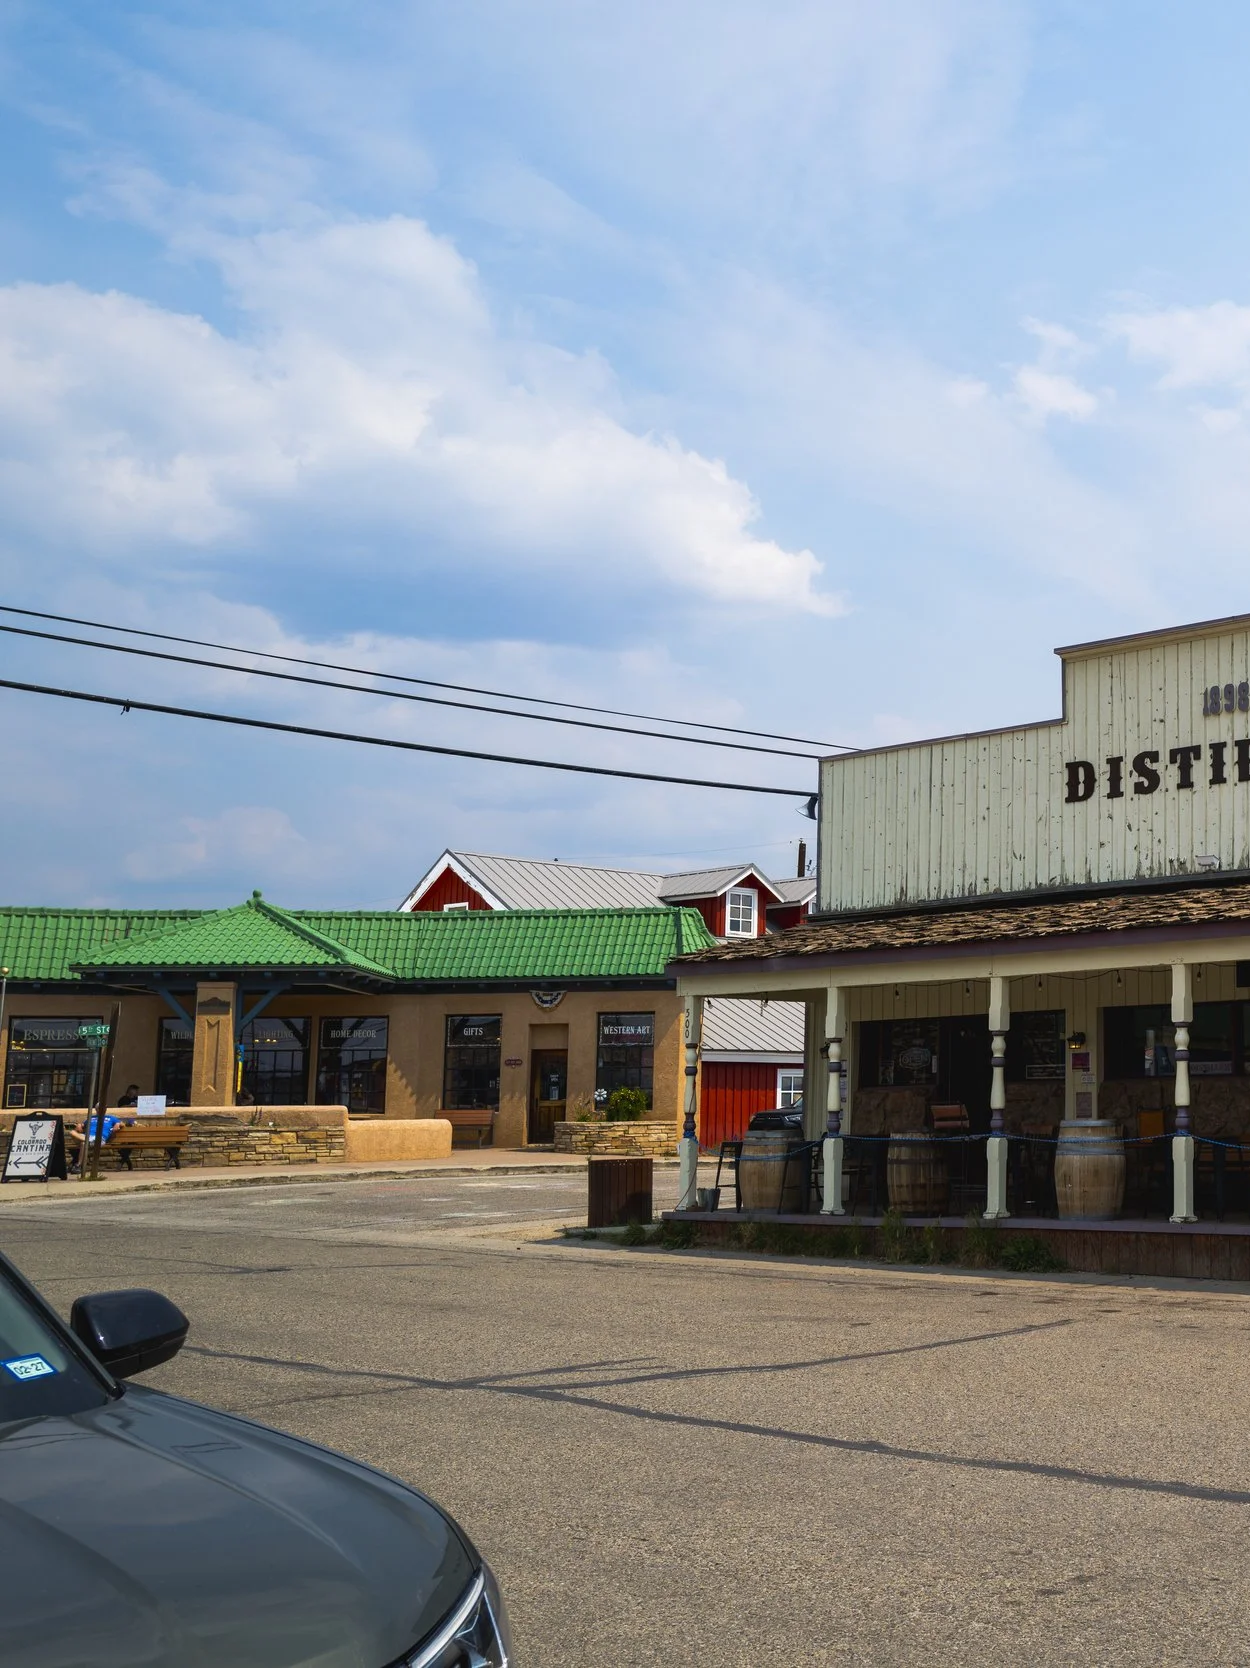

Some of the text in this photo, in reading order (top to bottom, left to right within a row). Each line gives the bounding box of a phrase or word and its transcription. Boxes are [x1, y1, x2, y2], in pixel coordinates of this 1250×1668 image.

[1203, 681, 1250, 716] 1898
[330, 1029, 377, 1039] HOME DECOR
[463, 1027, 484, 1036] GIFTS
[603, 1025, 651, 1035] WESTERN ART
[10, 1144, 52, 1153] CANTINA
